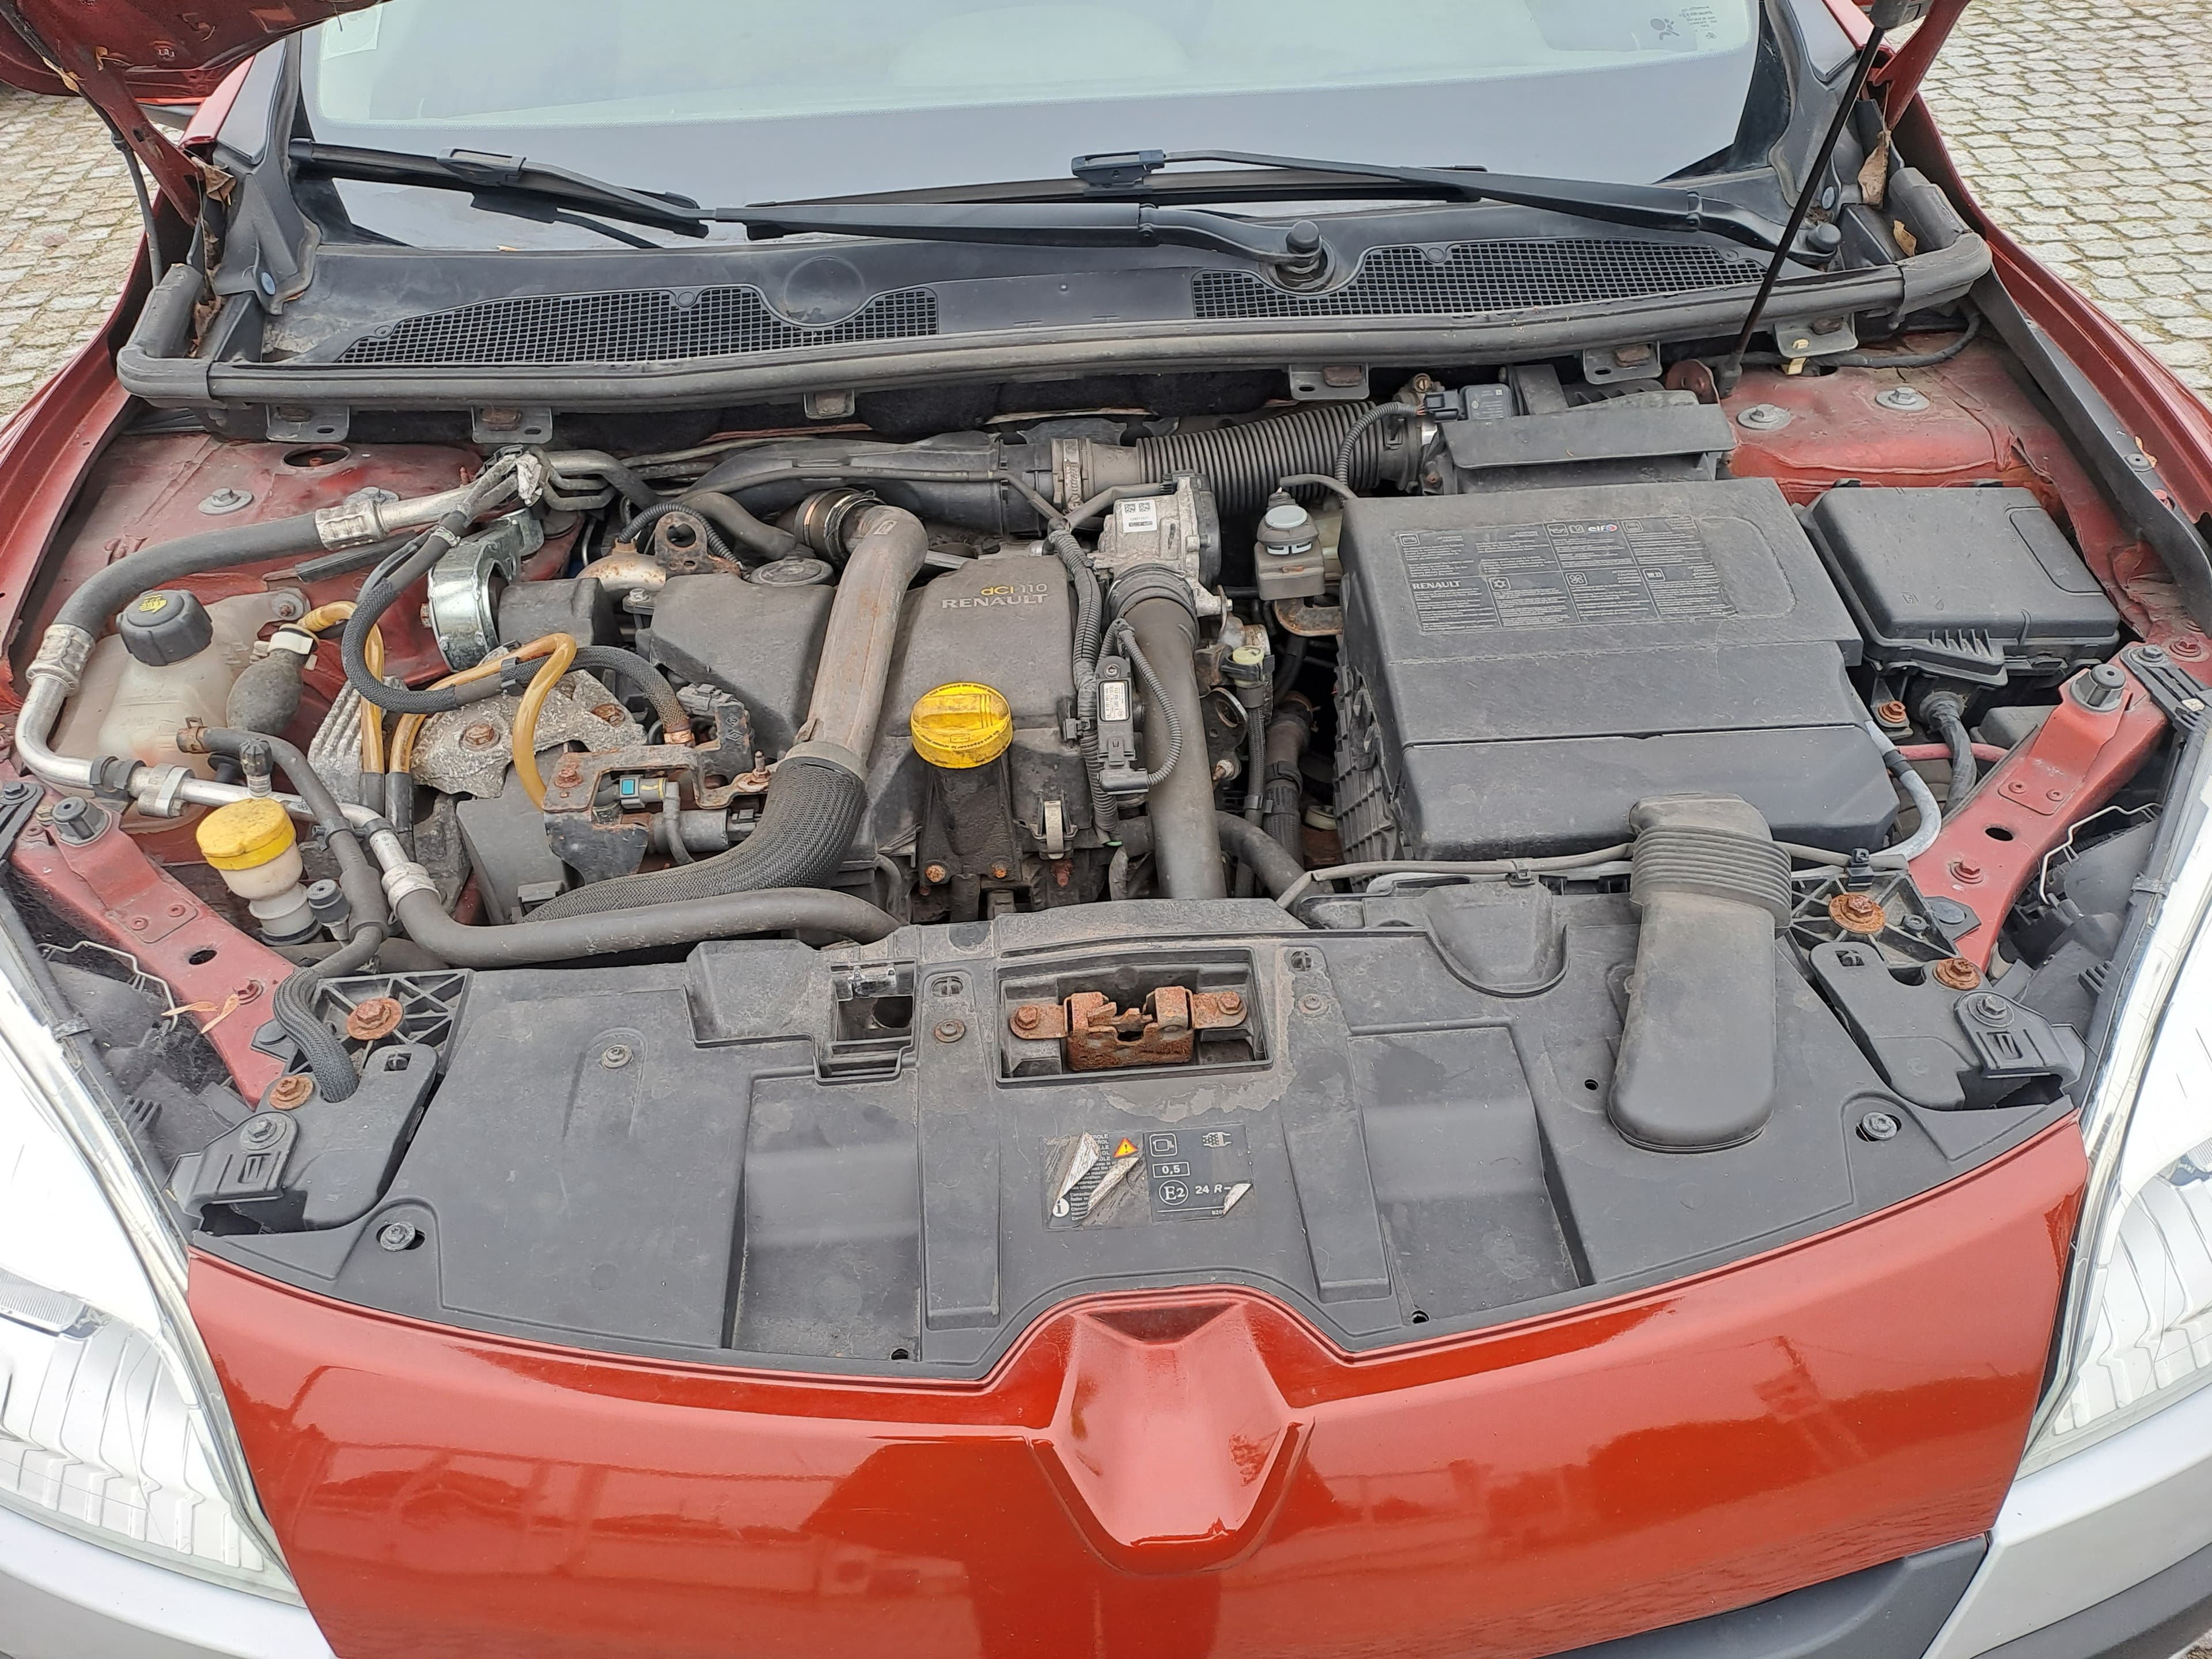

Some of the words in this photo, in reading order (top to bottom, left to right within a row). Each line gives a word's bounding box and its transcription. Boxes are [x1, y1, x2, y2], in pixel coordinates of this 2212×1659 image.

[1020, 584, 1048, 593] 110
[1412, 581, 1461, 589] RENAULT
[942, 594, 1048, 609] RENAULT
[1162, 1165, 1180, 1175] 0,5
[1164, 1186, 1185, 1200] E2
[1195, 1185, 1210, 1194] 24
